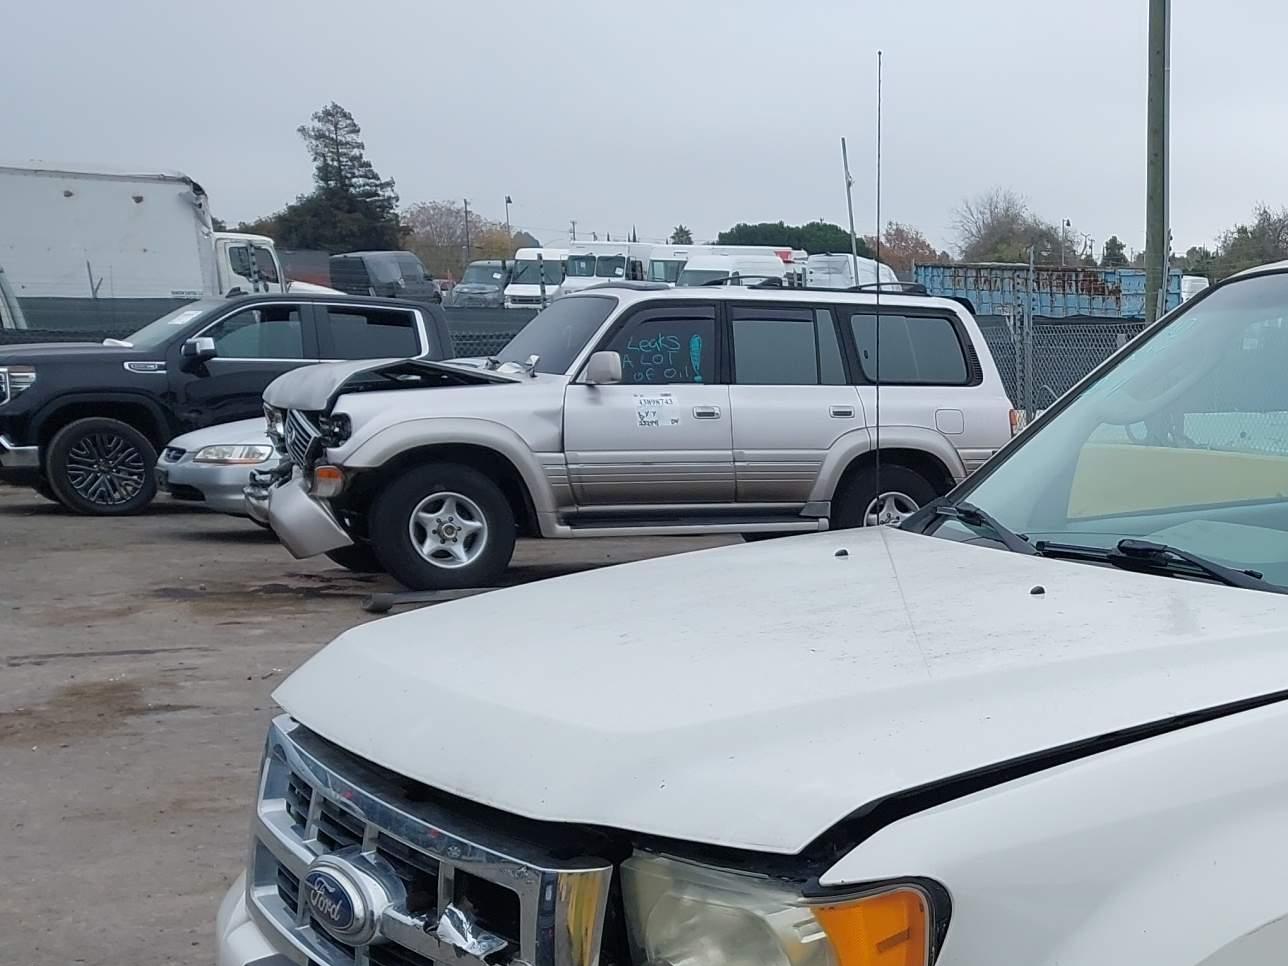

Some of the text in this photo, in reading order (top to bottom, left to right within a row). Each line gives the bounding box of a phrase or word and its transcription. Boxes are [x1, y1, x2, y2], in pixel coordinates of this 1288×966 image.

[622, 351, 680, 369] A LOT
[309, 876, 342, 921] Ford
